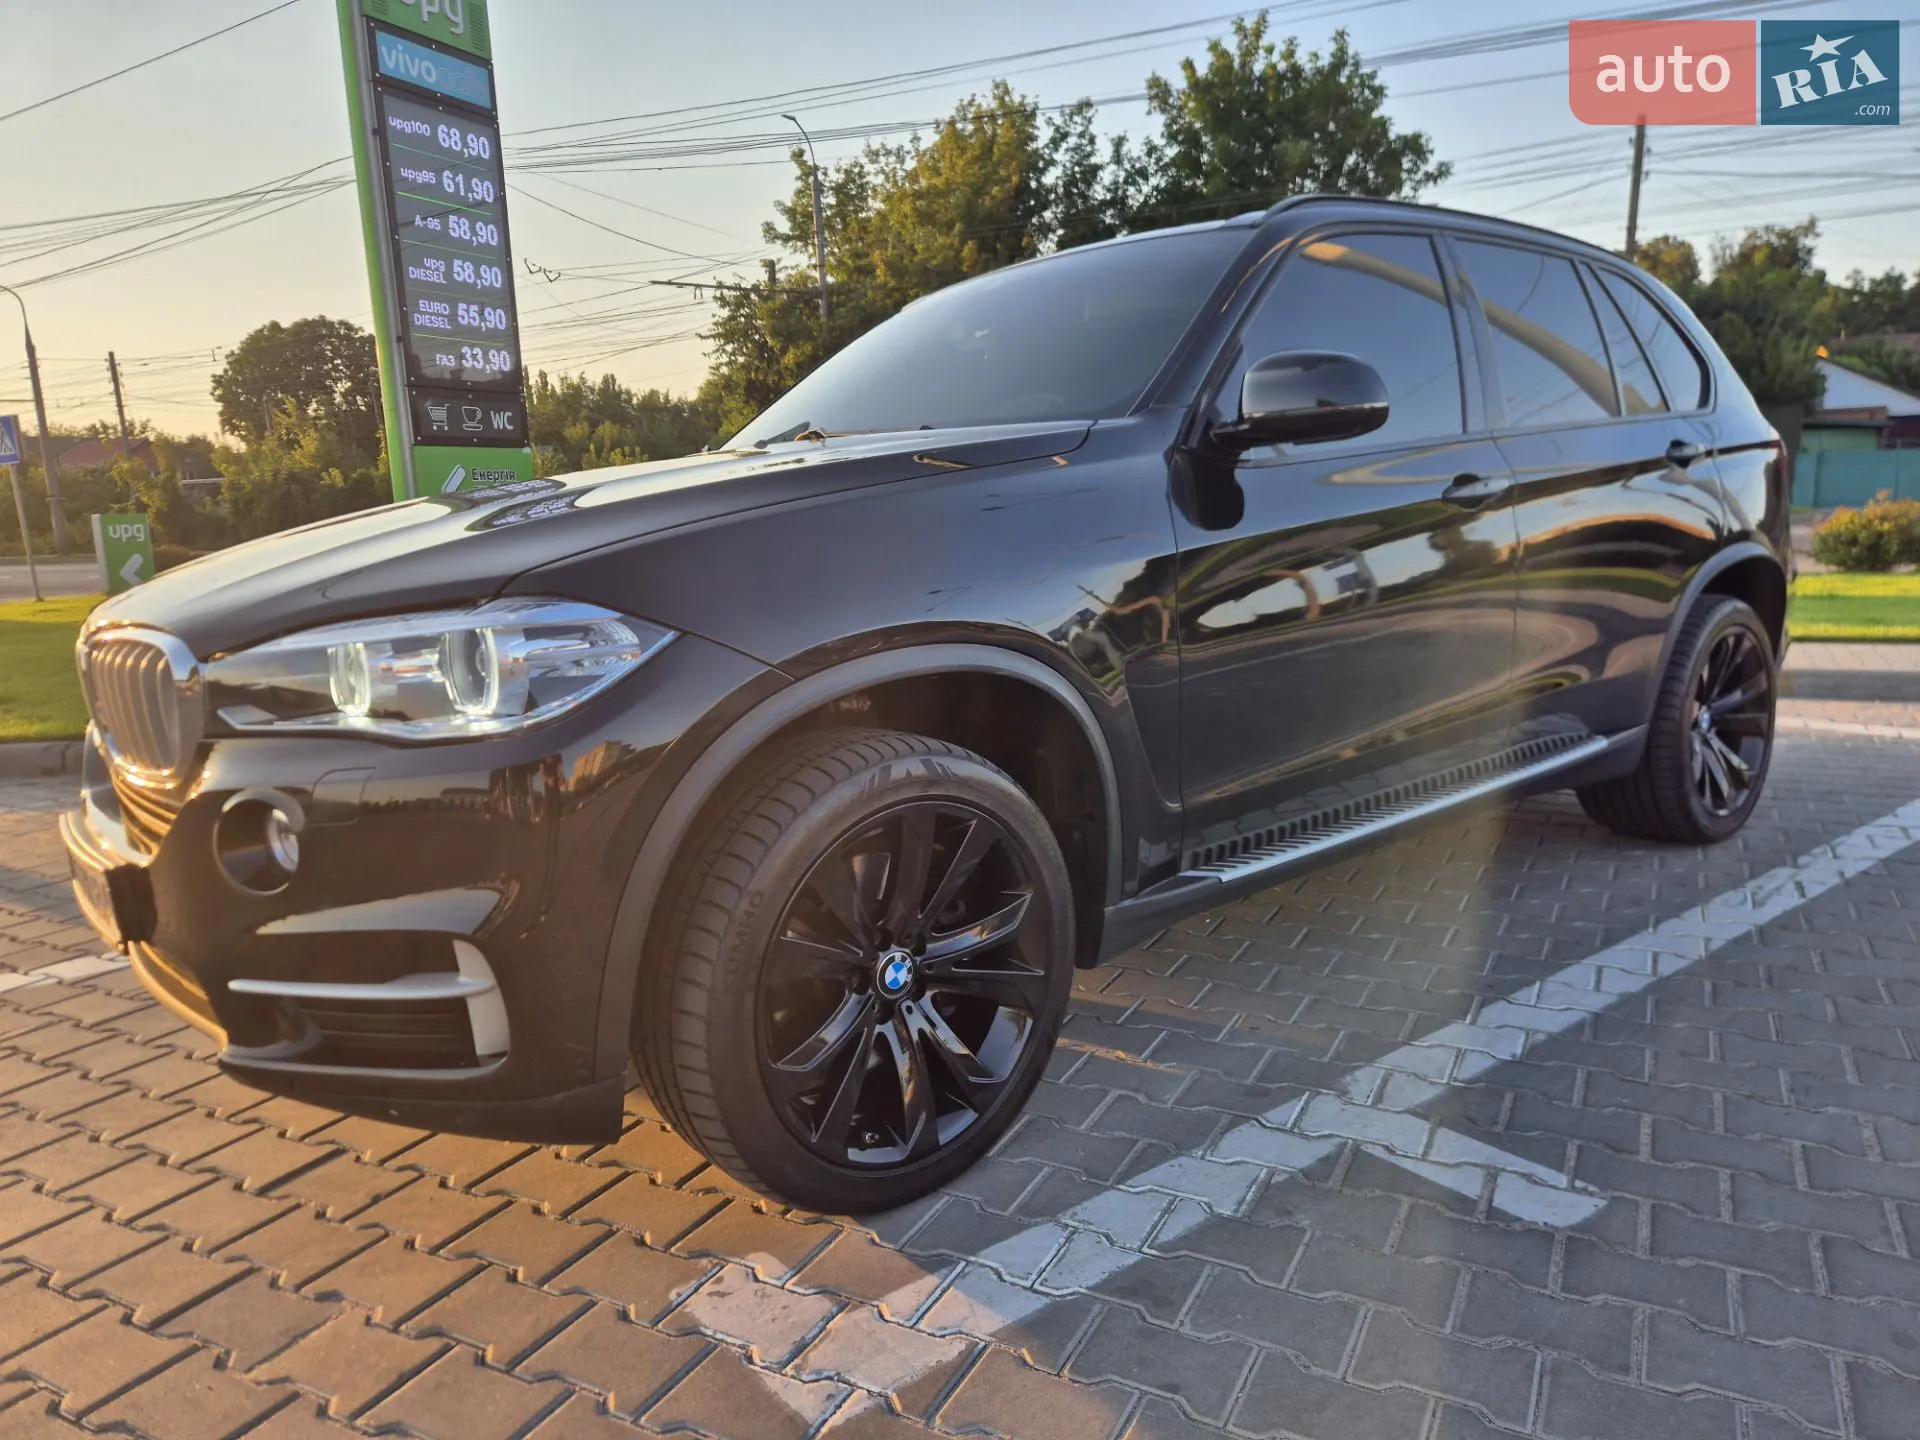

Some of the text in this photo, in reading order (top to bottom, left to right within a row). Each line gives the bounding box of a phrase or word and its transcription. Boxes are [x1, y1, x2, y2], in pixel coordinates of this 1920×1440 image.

[400, 0, 463, 34] pg
[381, 44, 436, 83] vivo
[389, 116, 490, 159] upg100 68,90
[400, 167, 494, 203] upg95 61,90
[415, 215, 498, 245] A-95 58,90
[409, 266, 447, 283] DIESEL
[424, 258, 446, 273] upg
[453, 259, 502, 288] 58,90
[419, 300, 450, 314] EURO
[457, 303, 506, 331] 55,90
[414, 313, 452, 329] DIESEL
[461, 346, 511, 373] 33,90
[490, 411, 514, 430] WC
[472, 467, 516, 483] Енергія
[108, 523, 145, 543] upg
